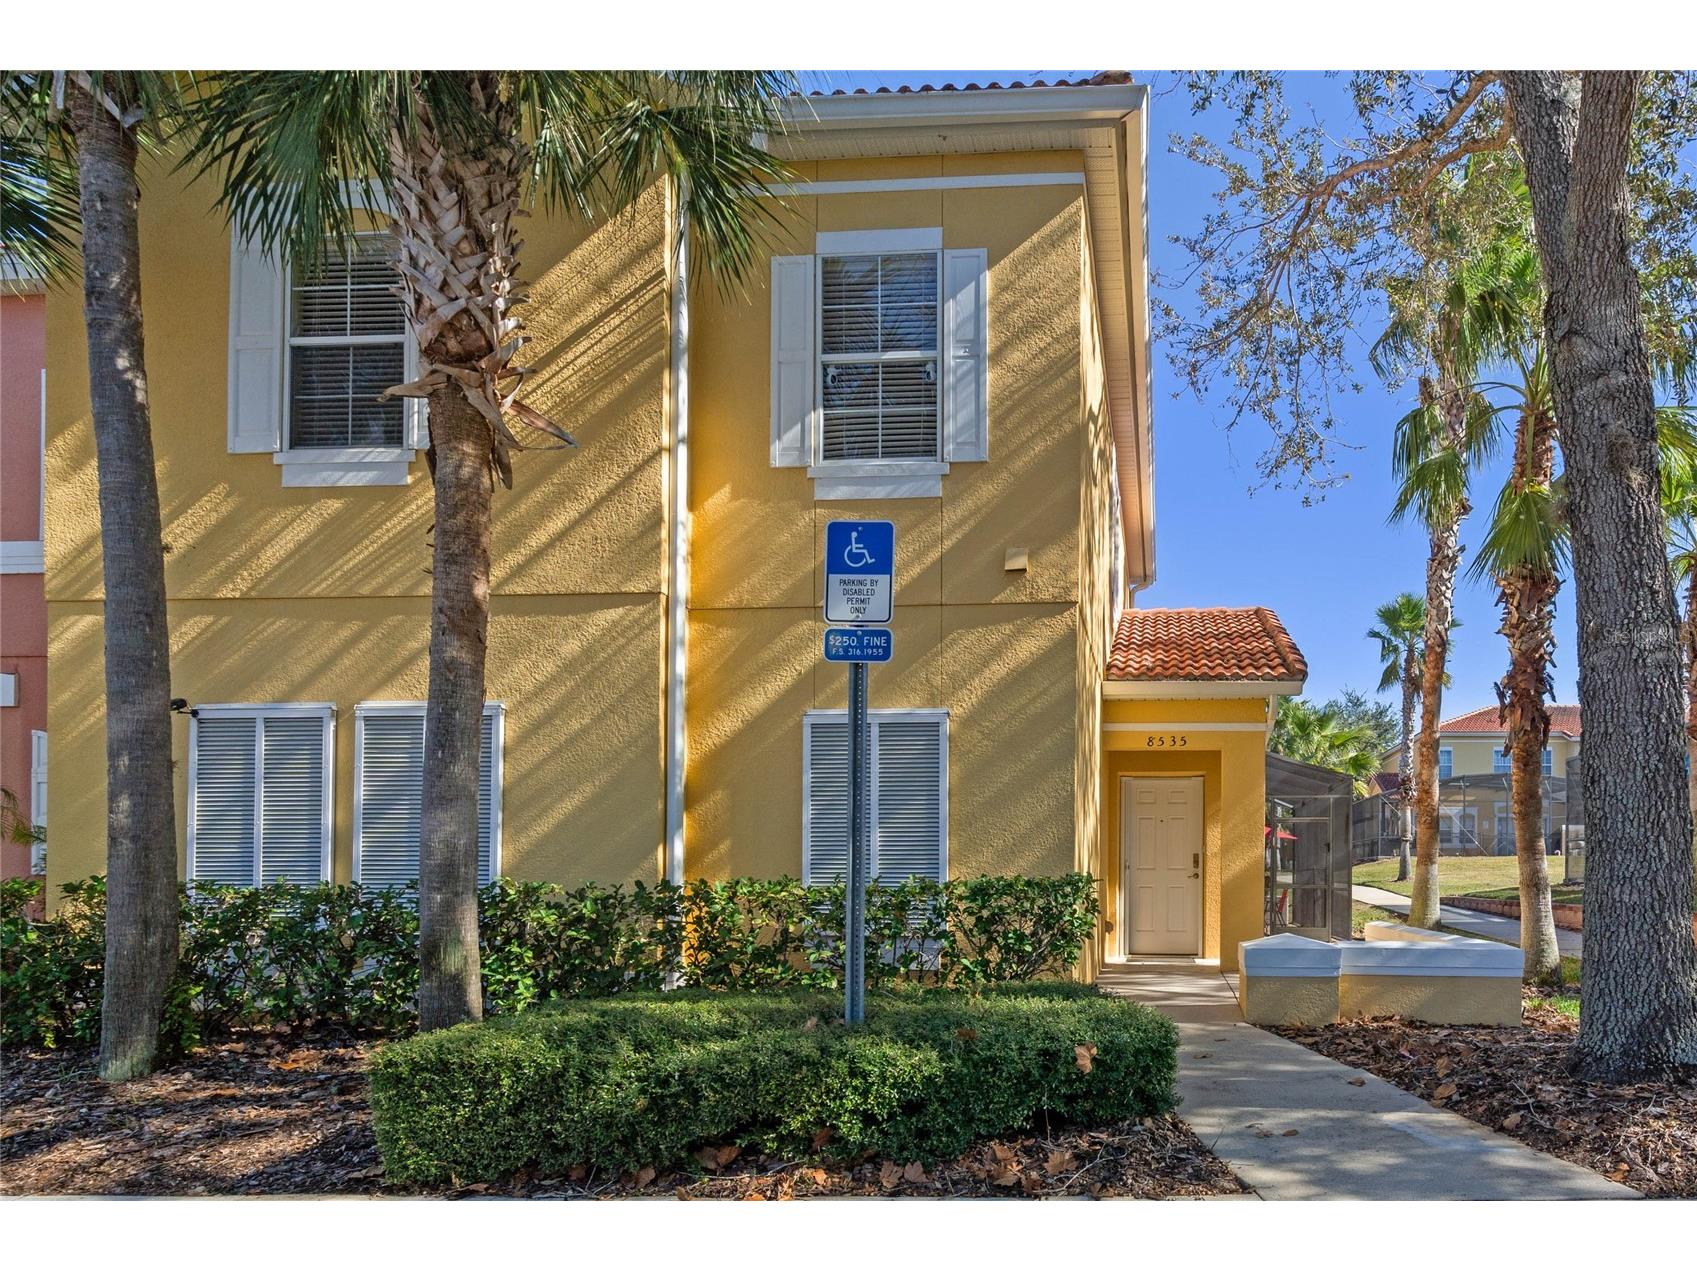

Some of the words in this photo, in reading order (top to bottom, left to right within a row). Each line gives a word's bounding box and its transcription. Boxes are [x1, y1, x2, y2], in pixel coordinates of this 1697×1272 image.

[839, 578, 868, 587] PARKING
[869, 578, 880, 587] BY
[842, 588, 876, 596] DISABLED
[846, 597, 871, 606] PERMIT
[849, 606, 867, 614] ONLY
[863, 636, 888, 647] FINE
[1146, 735, 1187, 747] 8535
